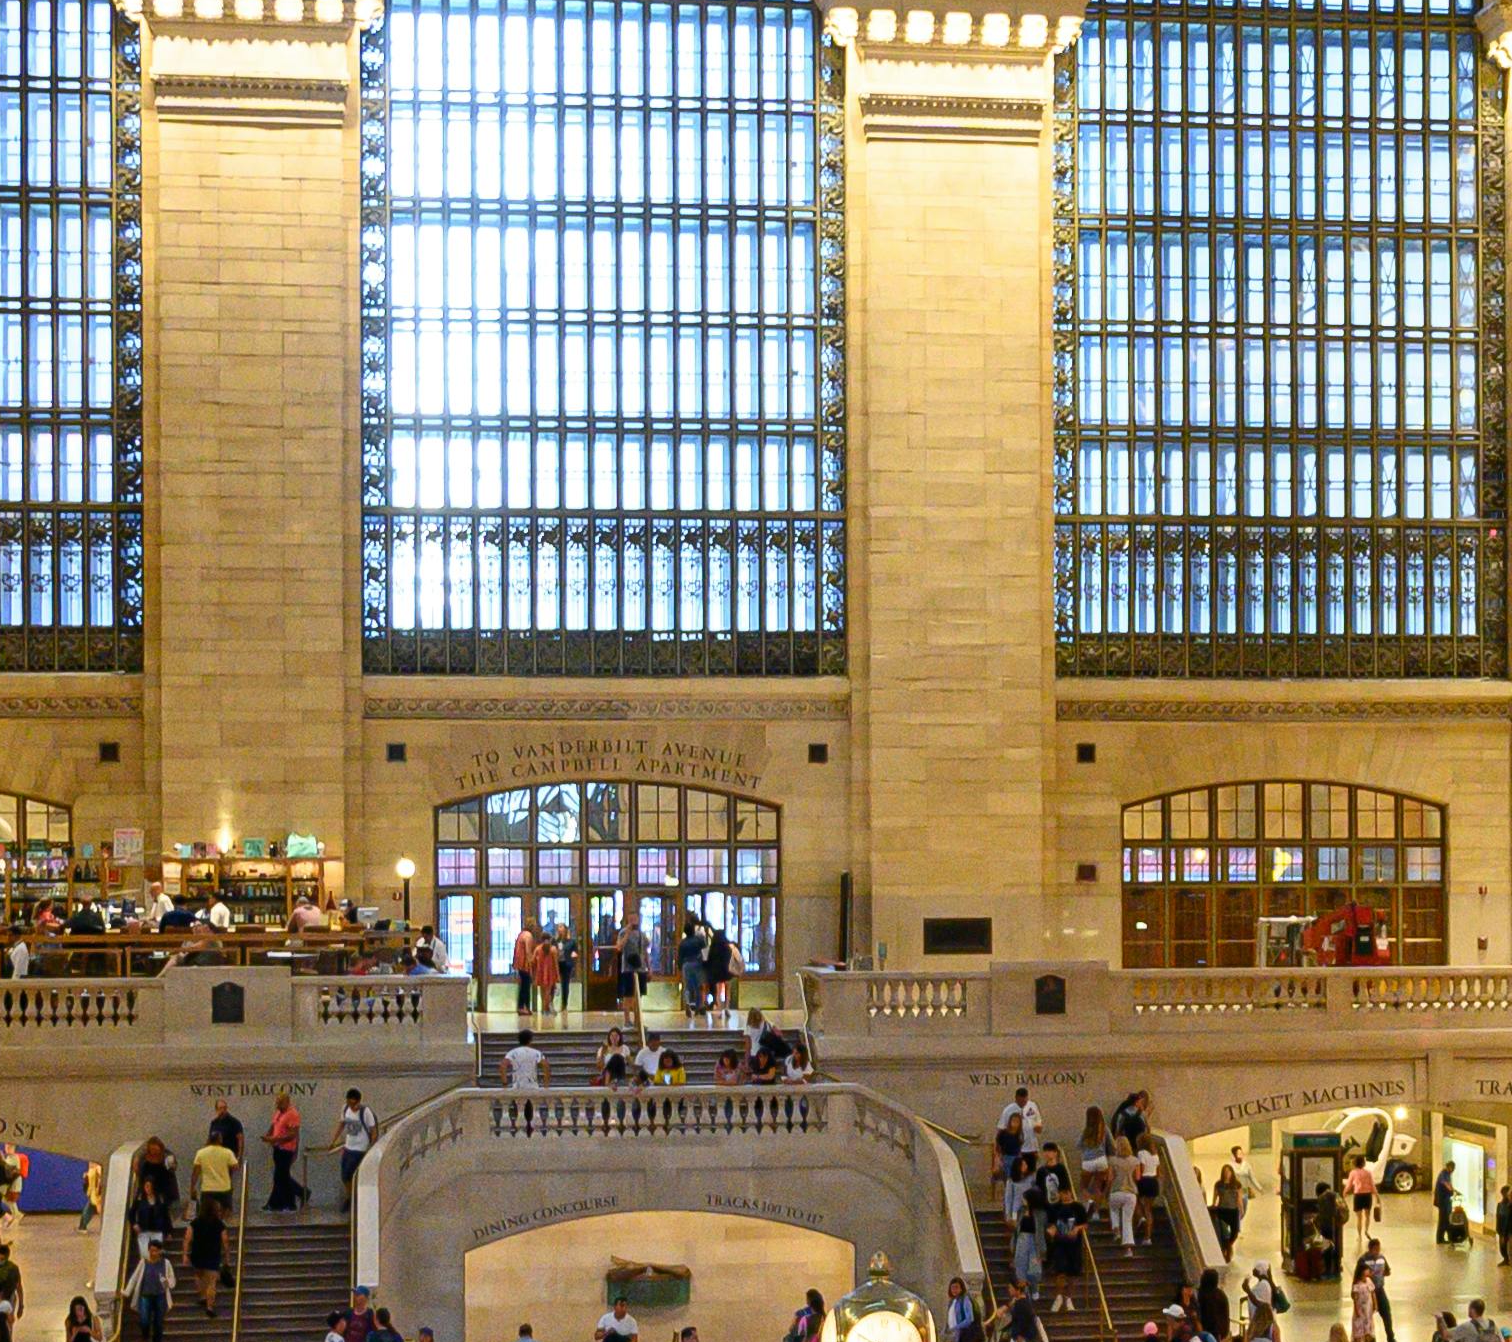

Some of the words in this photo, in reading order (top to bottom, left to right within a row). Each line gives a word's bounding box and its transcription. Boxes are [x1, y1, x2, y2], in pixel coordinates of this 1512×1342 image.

[472, 750, 499, 766] TO
[513, 739, 648, 759] VANDERBILT
[662, 743, 746, 767] AVENUE
[455, 770, 499, 790] THE
[512, 758, 622, 778] CAMPBELL
[636, 758, 761, 790] APARTMENT
[190, 1083, 233, 1096] WEST
[240, 1082, 317, 1096] BALCONY
[969, 1073, 1013, 1086] WEST
[1016, 1072, 1087, 1086] BALCONY
[1224, 1093, 1294, 1121] TICKET
[1301, 1079, 1406, 1107] MACHINES
[13, 1122, 40, 1141] ST
[472, 1214, 529, 1241] DINING
[532, 1195, 619, 1223] CONCOURSE
[705, 1194, 758, 1211] TRACKS
[784, 1206, 804, 1220] TO
